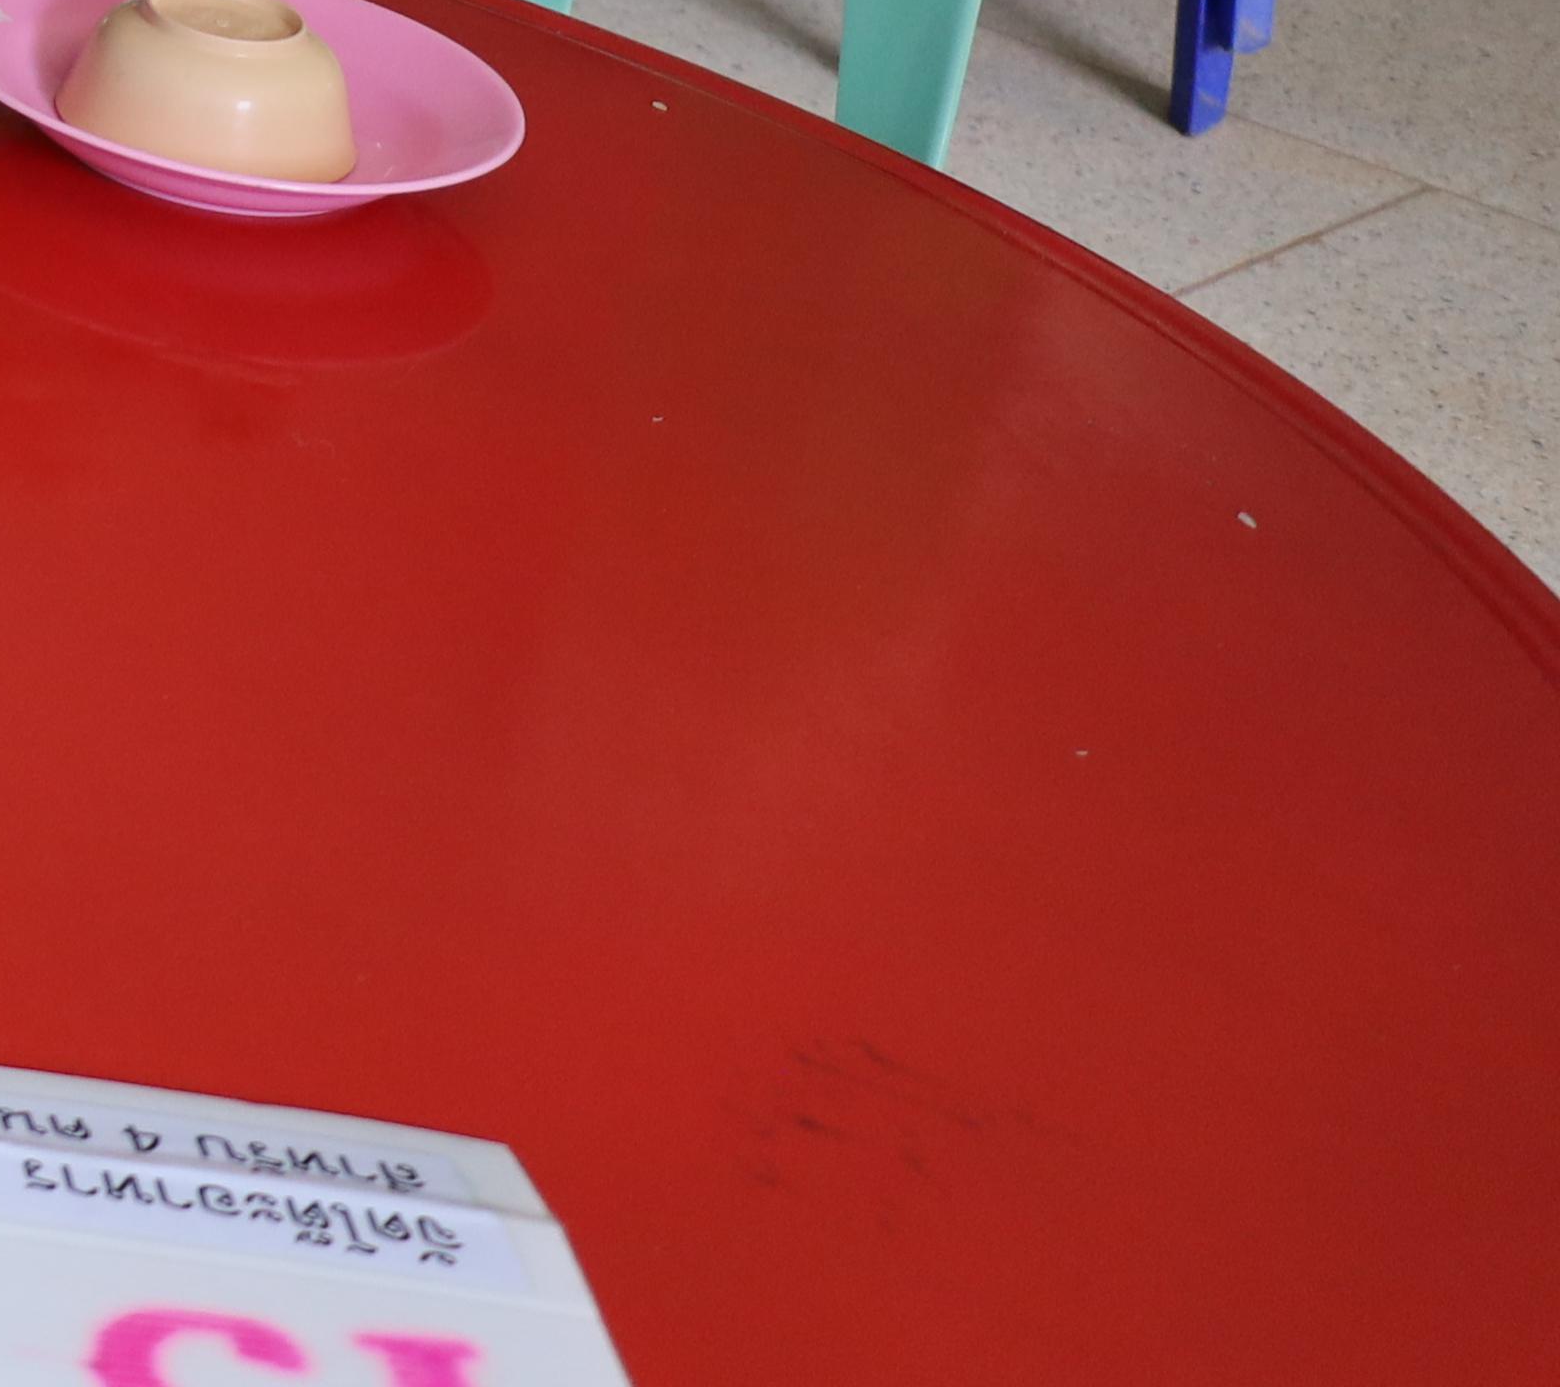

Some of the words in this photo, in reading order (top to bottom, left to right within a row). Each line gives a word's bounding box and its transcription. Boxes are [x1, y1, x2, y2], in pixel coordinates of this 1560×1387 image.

[123, 1124, 162, 1153] 4
[195, 1132, 425, 1193] สำหรับ
[22, 1156, 464, 1265] จัดโต๊ะอาหาร
